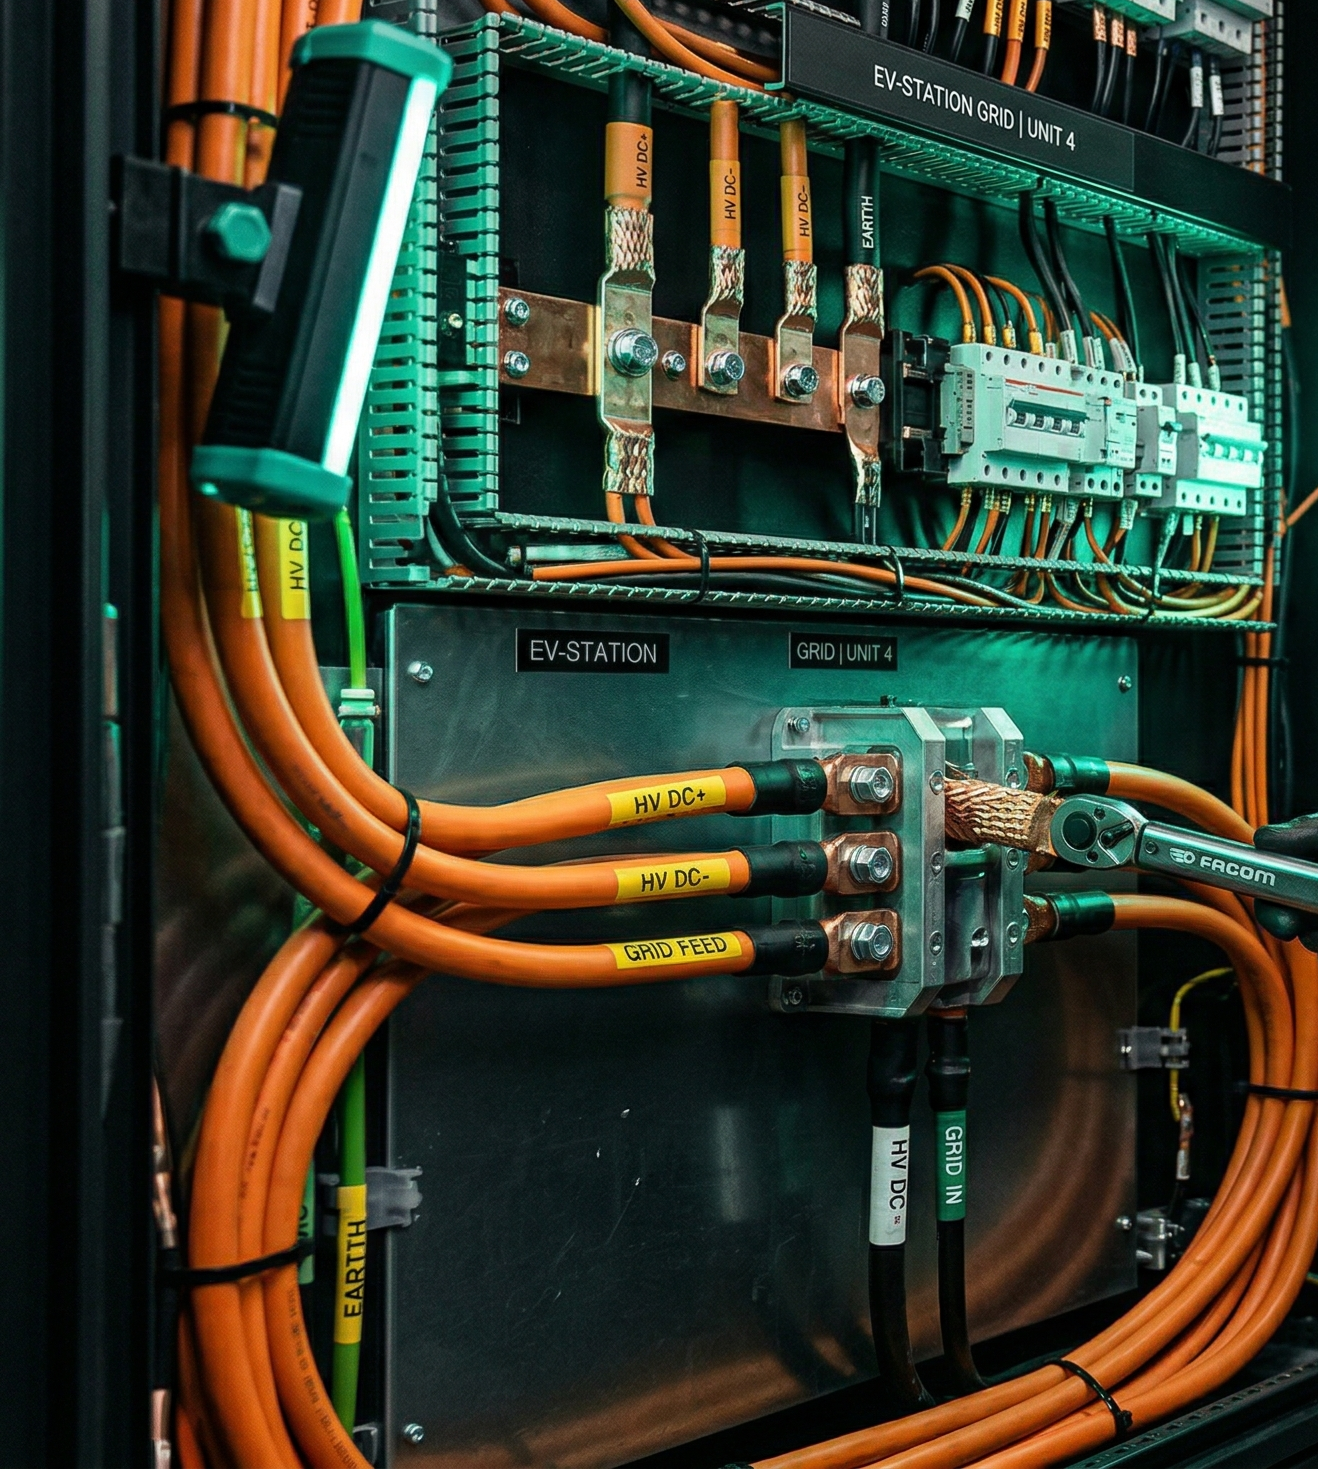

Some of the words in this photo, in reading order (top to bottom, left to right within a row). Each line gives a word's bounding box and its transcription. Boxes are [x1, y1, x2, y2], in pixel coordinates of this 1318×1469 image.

[874, 64, 973, 118] EV-STATION
[977, 100, 1015, 130] GRID
[1027, 116, 1064, 147] UNIT
[1066, 131, 1076, 152] 4
[637, 133, 649, 163] DC+
[636, 167, 648, 189] HV
[724, 168, 737, 196] DC-
[724, 200, 737, 220] HV
[798, 185, 810, 213] DC-
[799, 217, 811, 238] HV
[289, 561, 306, 590] HV
[530, 640, 657, 664] EV-STATION
[797, 642, 836, 662] GRID
[846, 644, 881, 662] UNIT
[884, 644, 893, 662] 4
[634, 792, 660, 814] HV
[668, 786, 706, 809] DC+
[641, 871, 668, 892] HV
[674, 867, 710, 888] DC-
[1200, 855, 1276, 887] FACOM
[623, 941, 673, 962] GRID
[678, 936, 728, 957] FEED
[891, 1139, 908, 1170] HV
[945, 1126, 963, 1176] GRID
[889, 1178, 906, 1210] DC
[945, 1185, 963, 1205] IN
